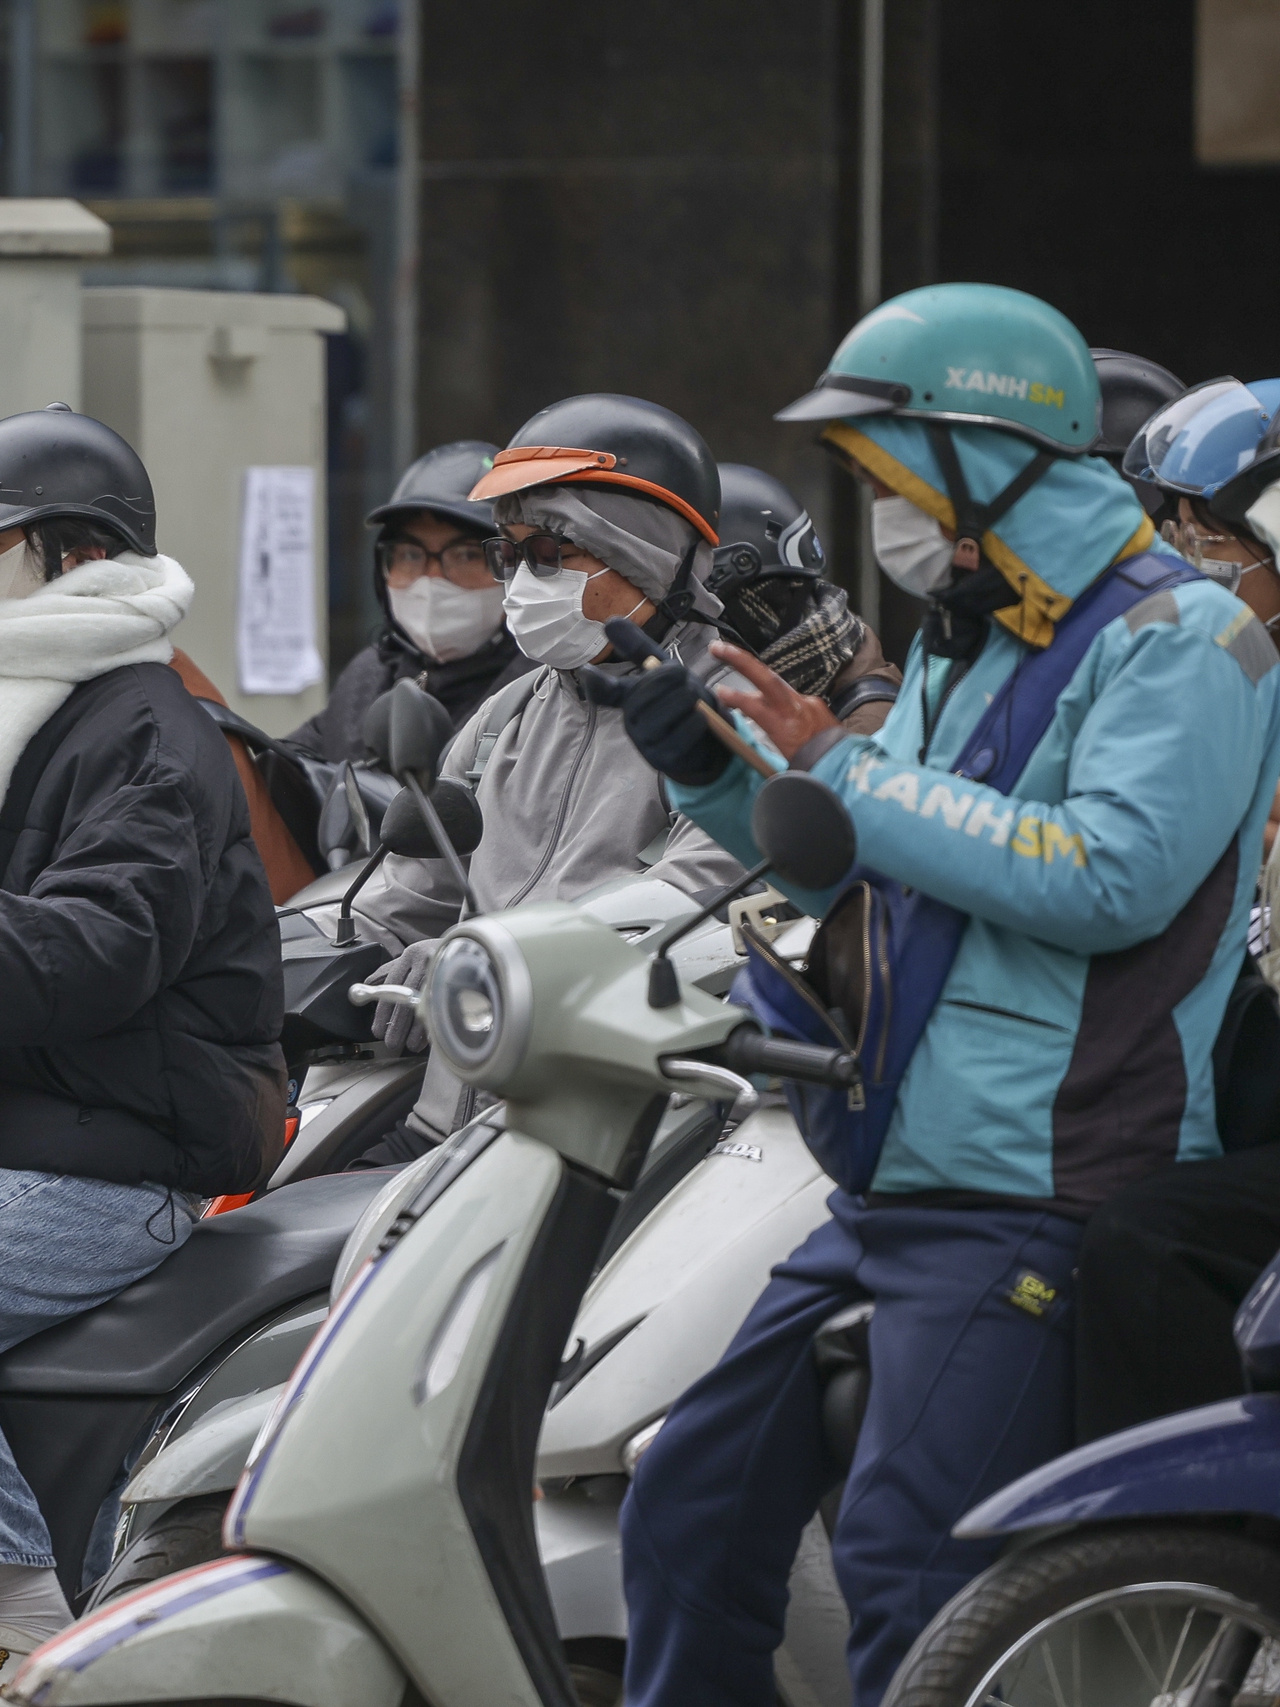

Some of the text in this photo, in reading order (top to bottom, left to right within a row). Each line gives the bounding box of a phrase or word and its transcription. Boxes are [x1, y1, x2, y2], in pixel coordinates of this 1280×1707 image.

[944, 366, 1065, 410] XANH SM
[847, 751, 1088, 868] XANH SM
